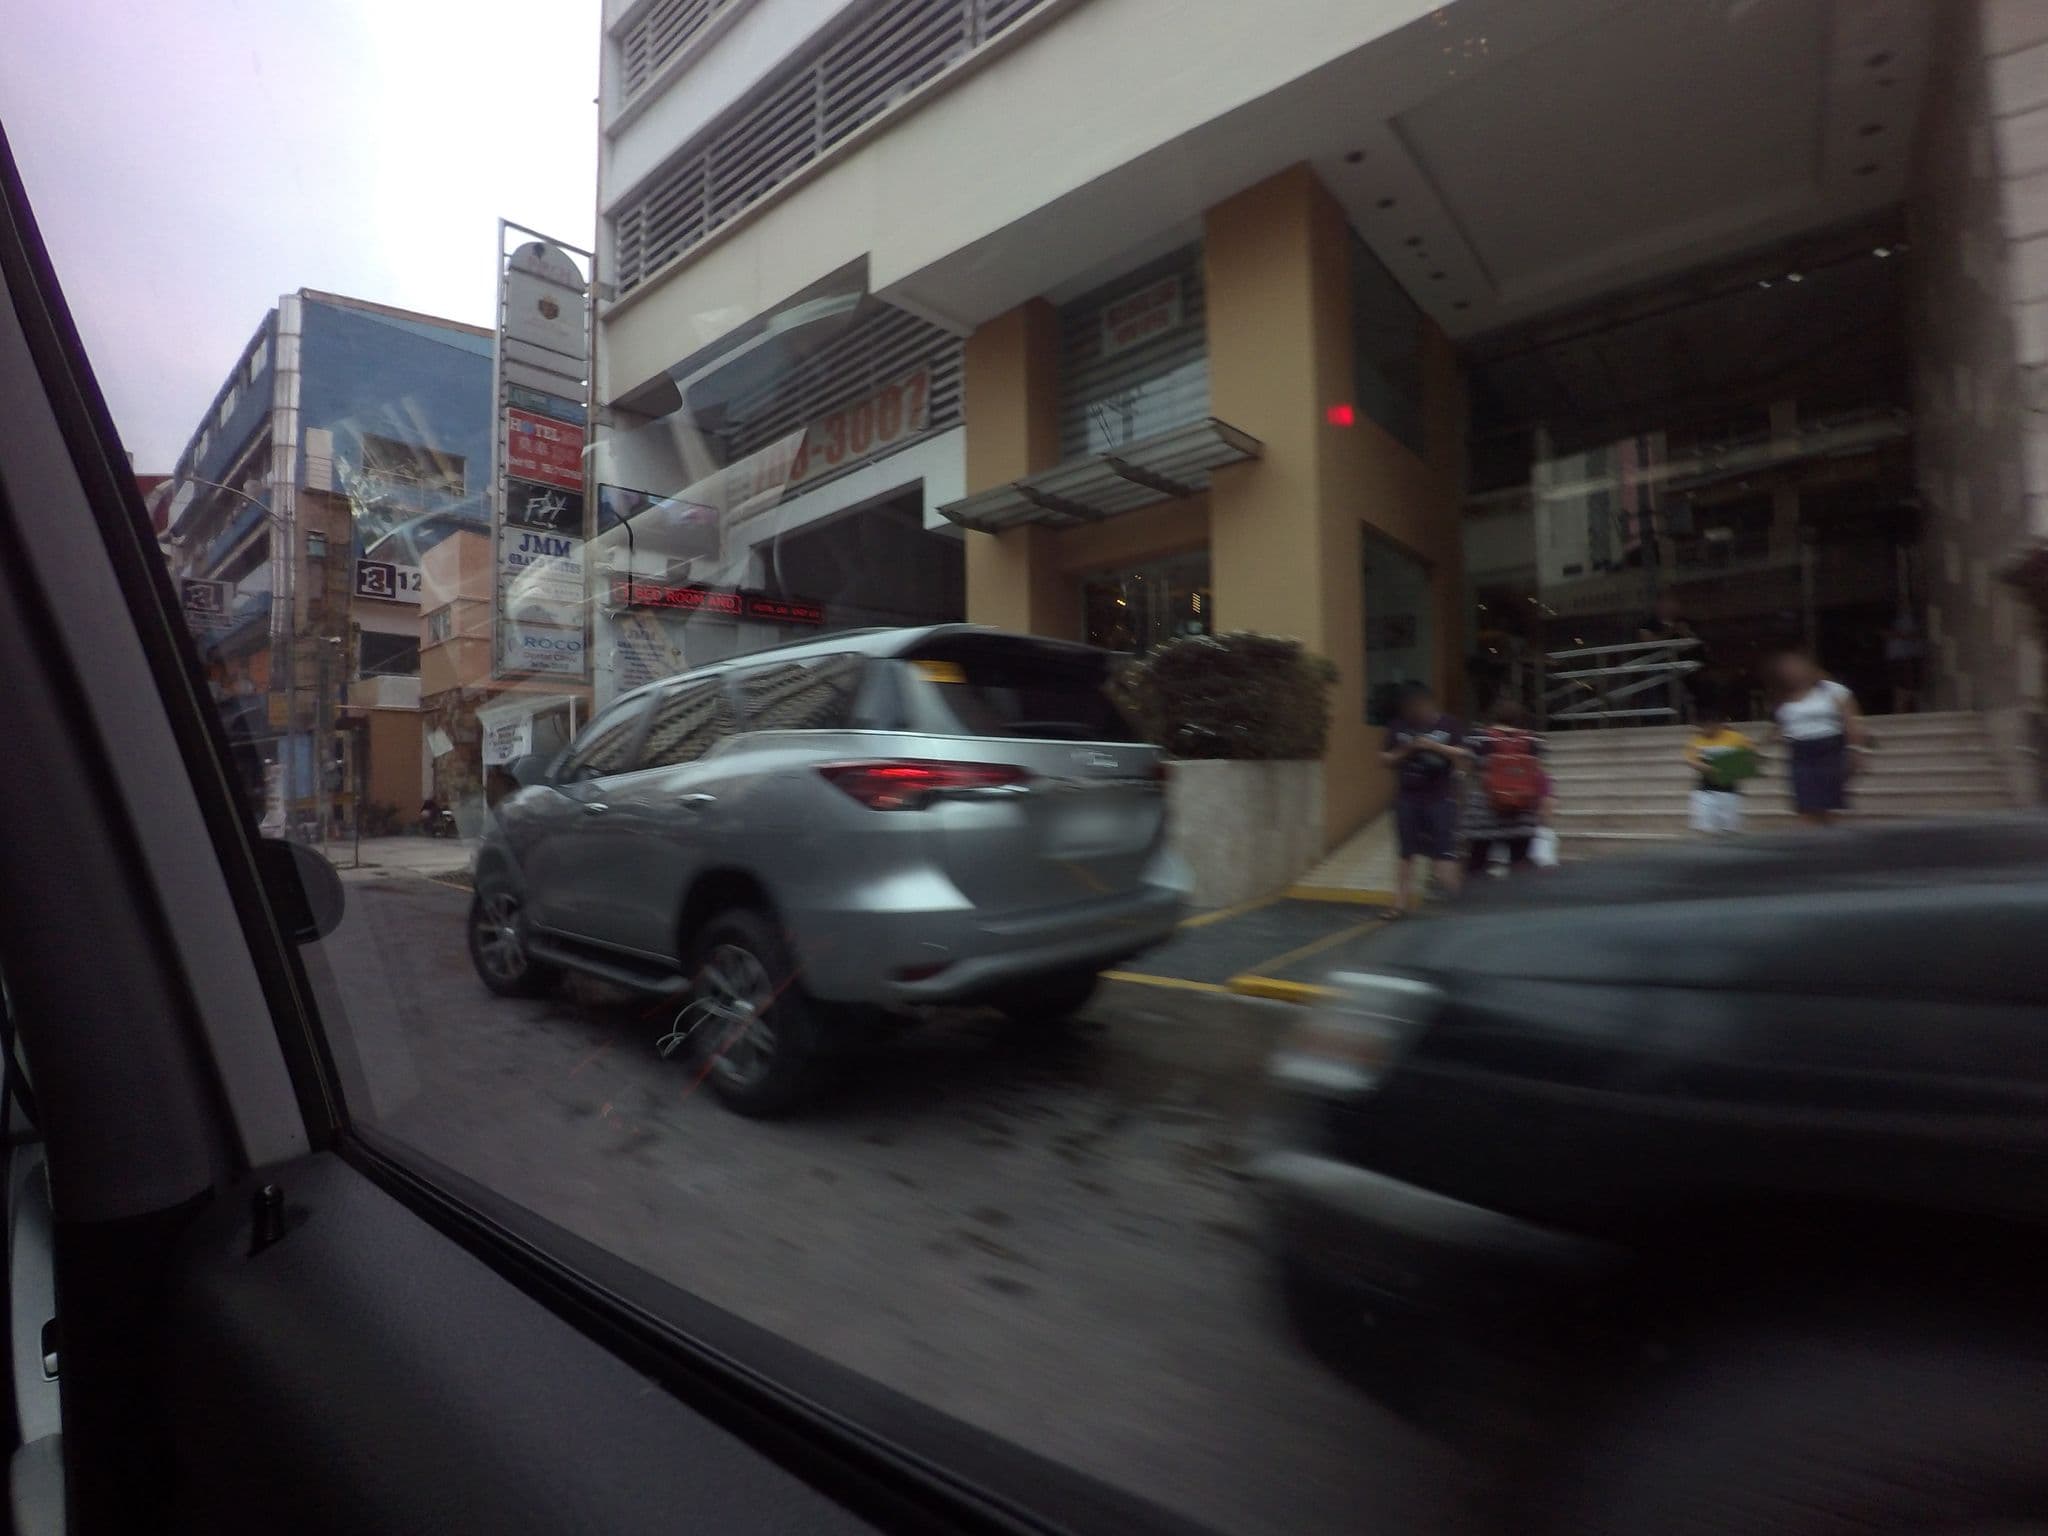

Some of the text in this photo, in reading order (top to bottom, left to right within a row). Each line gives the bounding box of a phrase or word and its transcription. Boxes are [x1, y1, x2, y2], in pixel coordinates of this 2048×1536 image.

[510, 417, 561, 441] HOTEL
[519, 533, 573, 558] JMM
[635, 586, 736, 609] BED ROOM AND
[524, 635, 581, 651] ROCO
